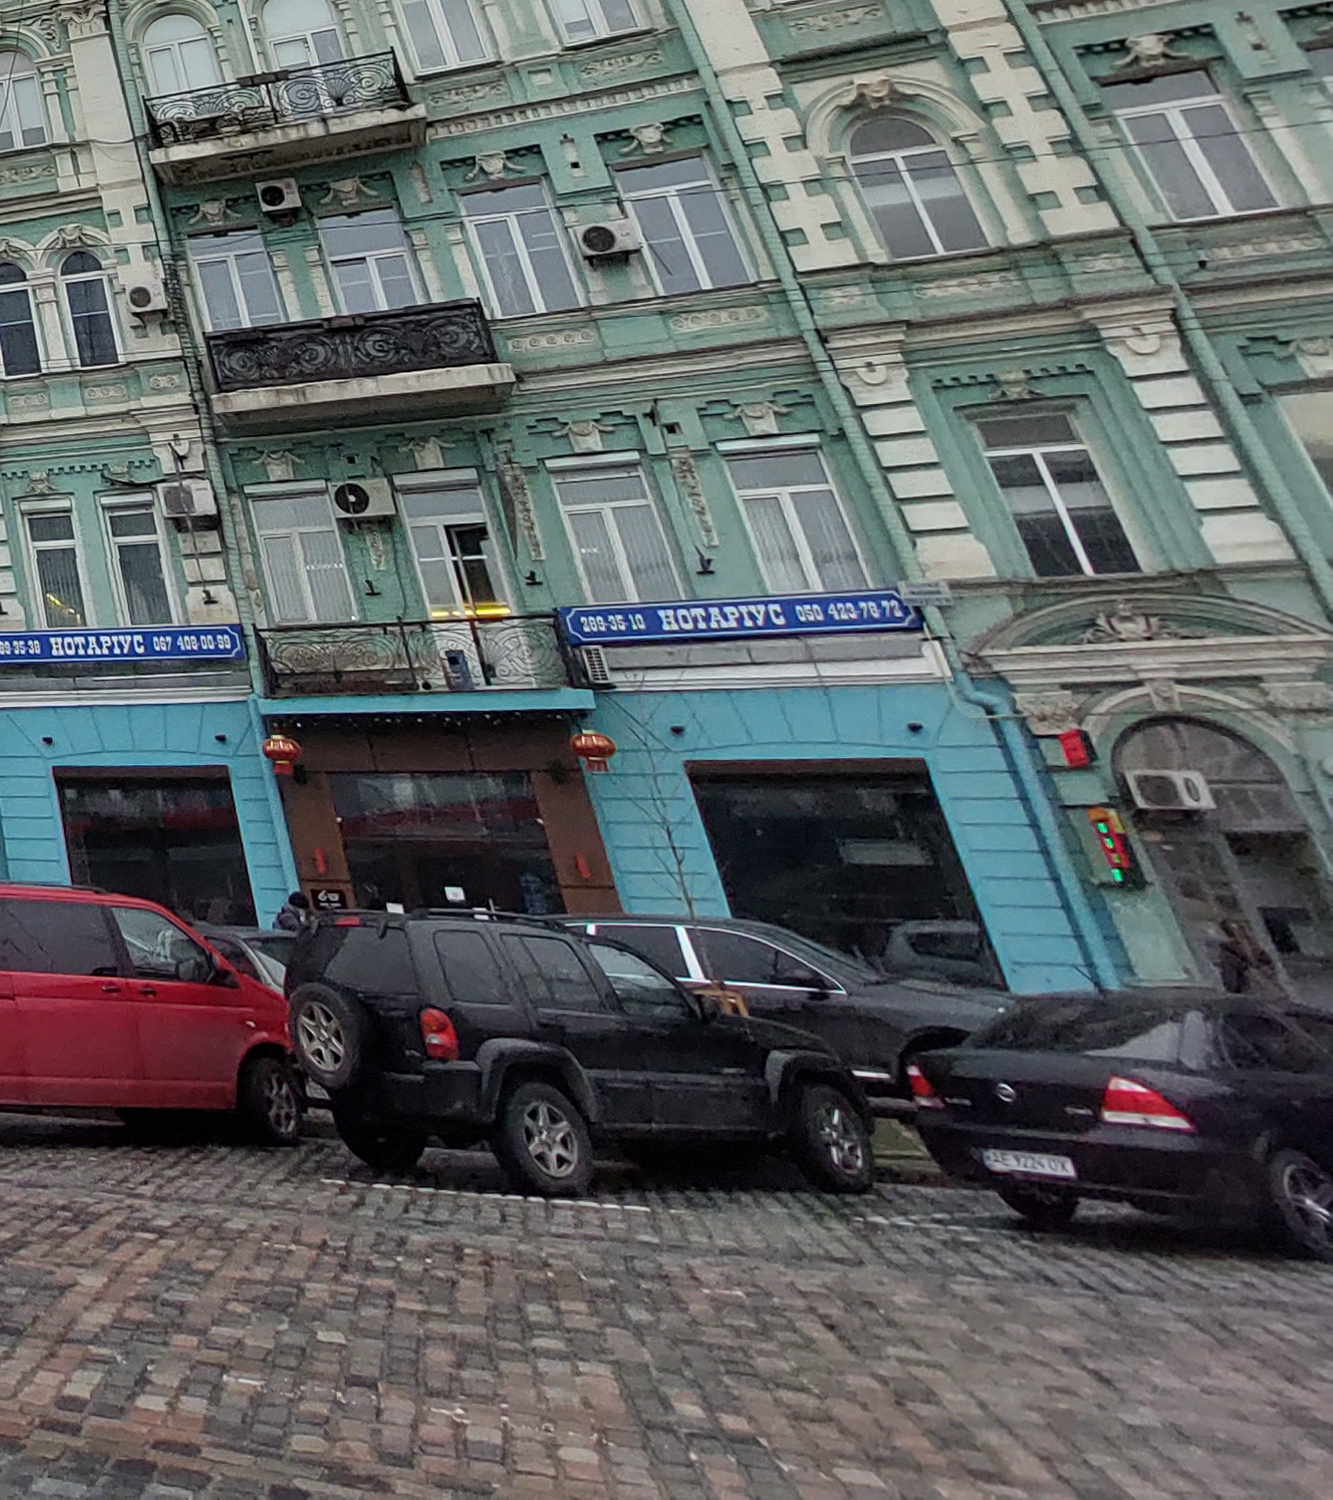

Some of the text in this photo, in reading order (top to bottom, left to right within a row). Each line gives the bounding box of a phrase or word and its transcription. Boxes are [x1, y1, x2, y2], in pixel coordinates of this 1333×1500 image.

[657, 603, 786, 632] НОТАРІУС
[796, 604, 822, 622] 050
[49, 635, 145, 656] НОТАРІУС
[152, 636, 172, 651] 067
